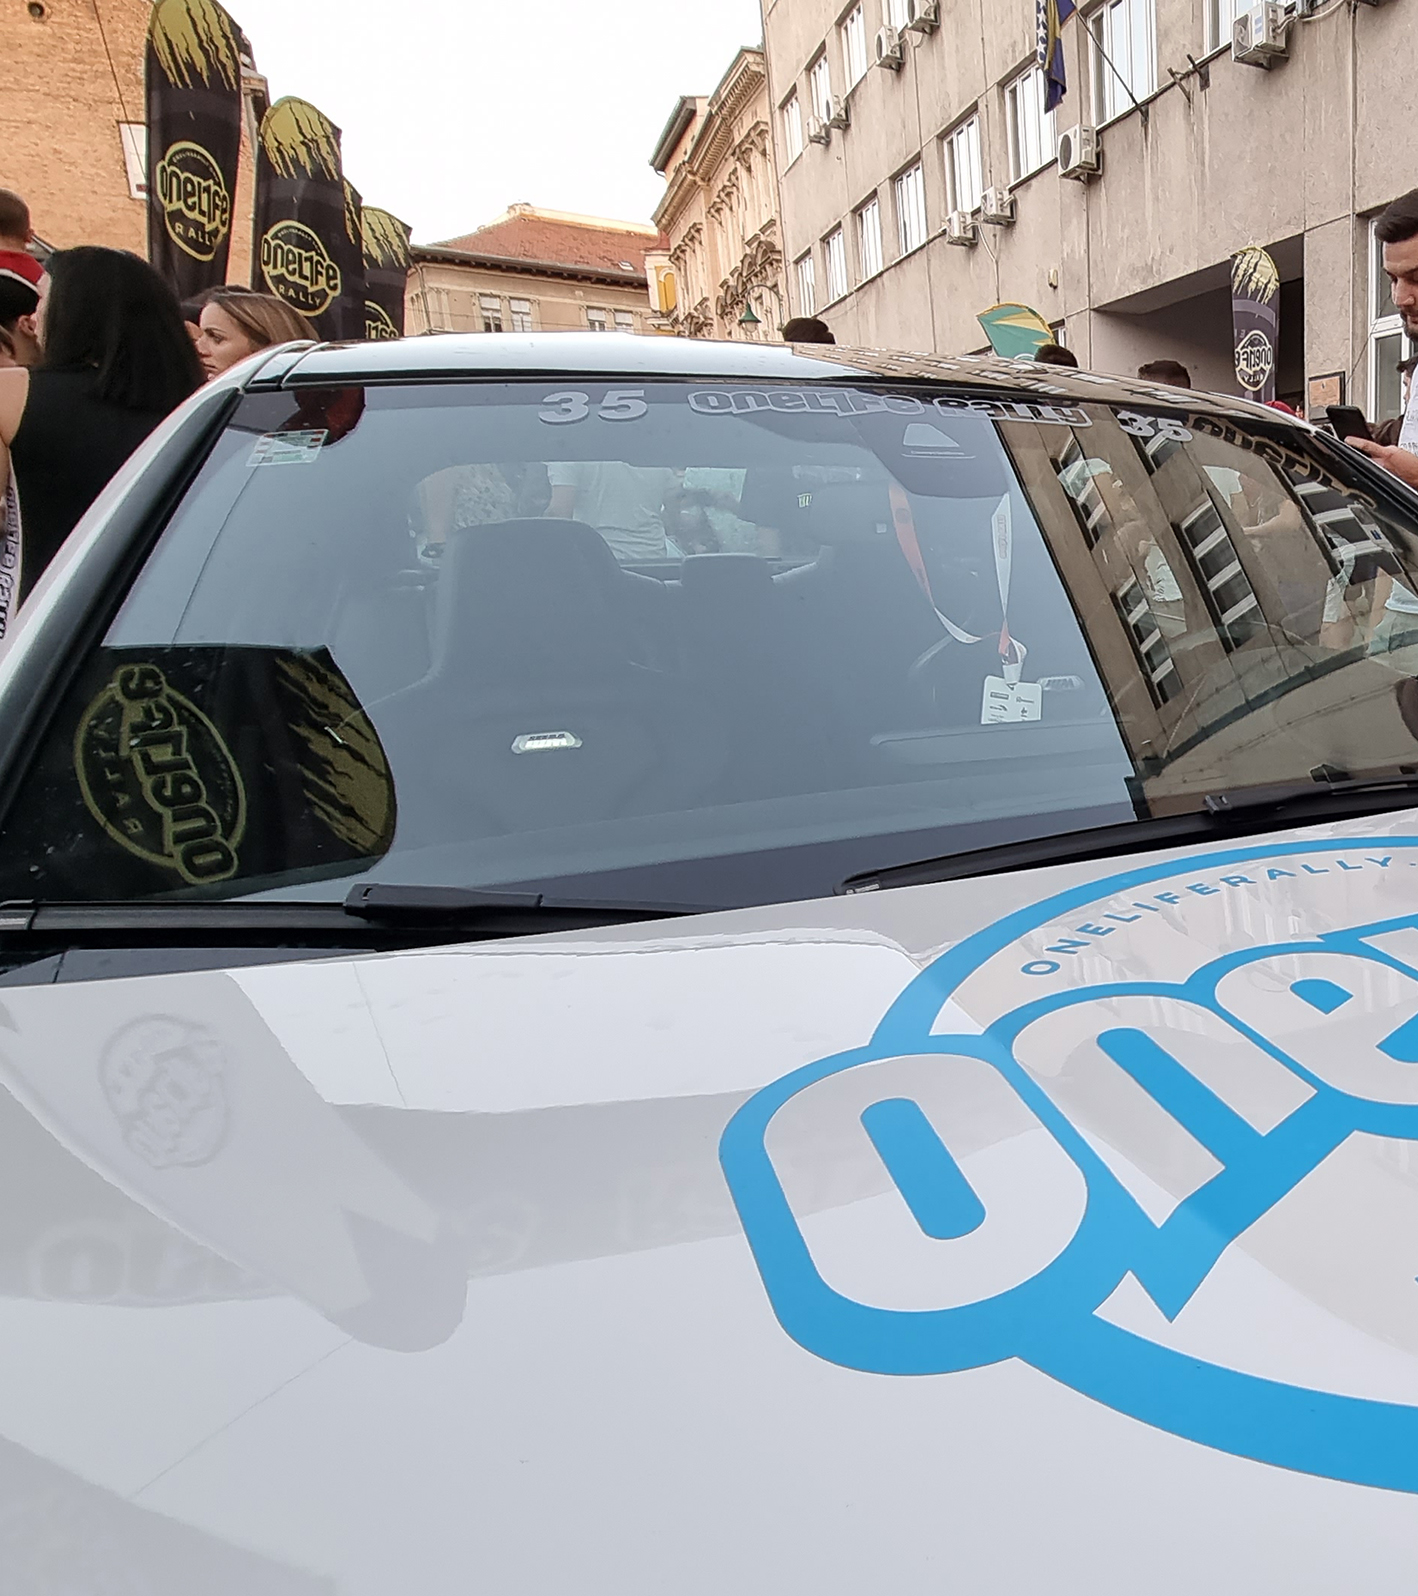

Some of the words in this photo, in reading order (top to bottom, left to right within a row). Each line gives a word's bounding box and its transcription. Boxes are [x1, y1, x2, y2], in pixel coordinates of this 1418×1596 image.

[278, 284, 321, 306] RALLY
[538, 389, 648, 425] 35
[1117, 410, 1194, 442] 35
